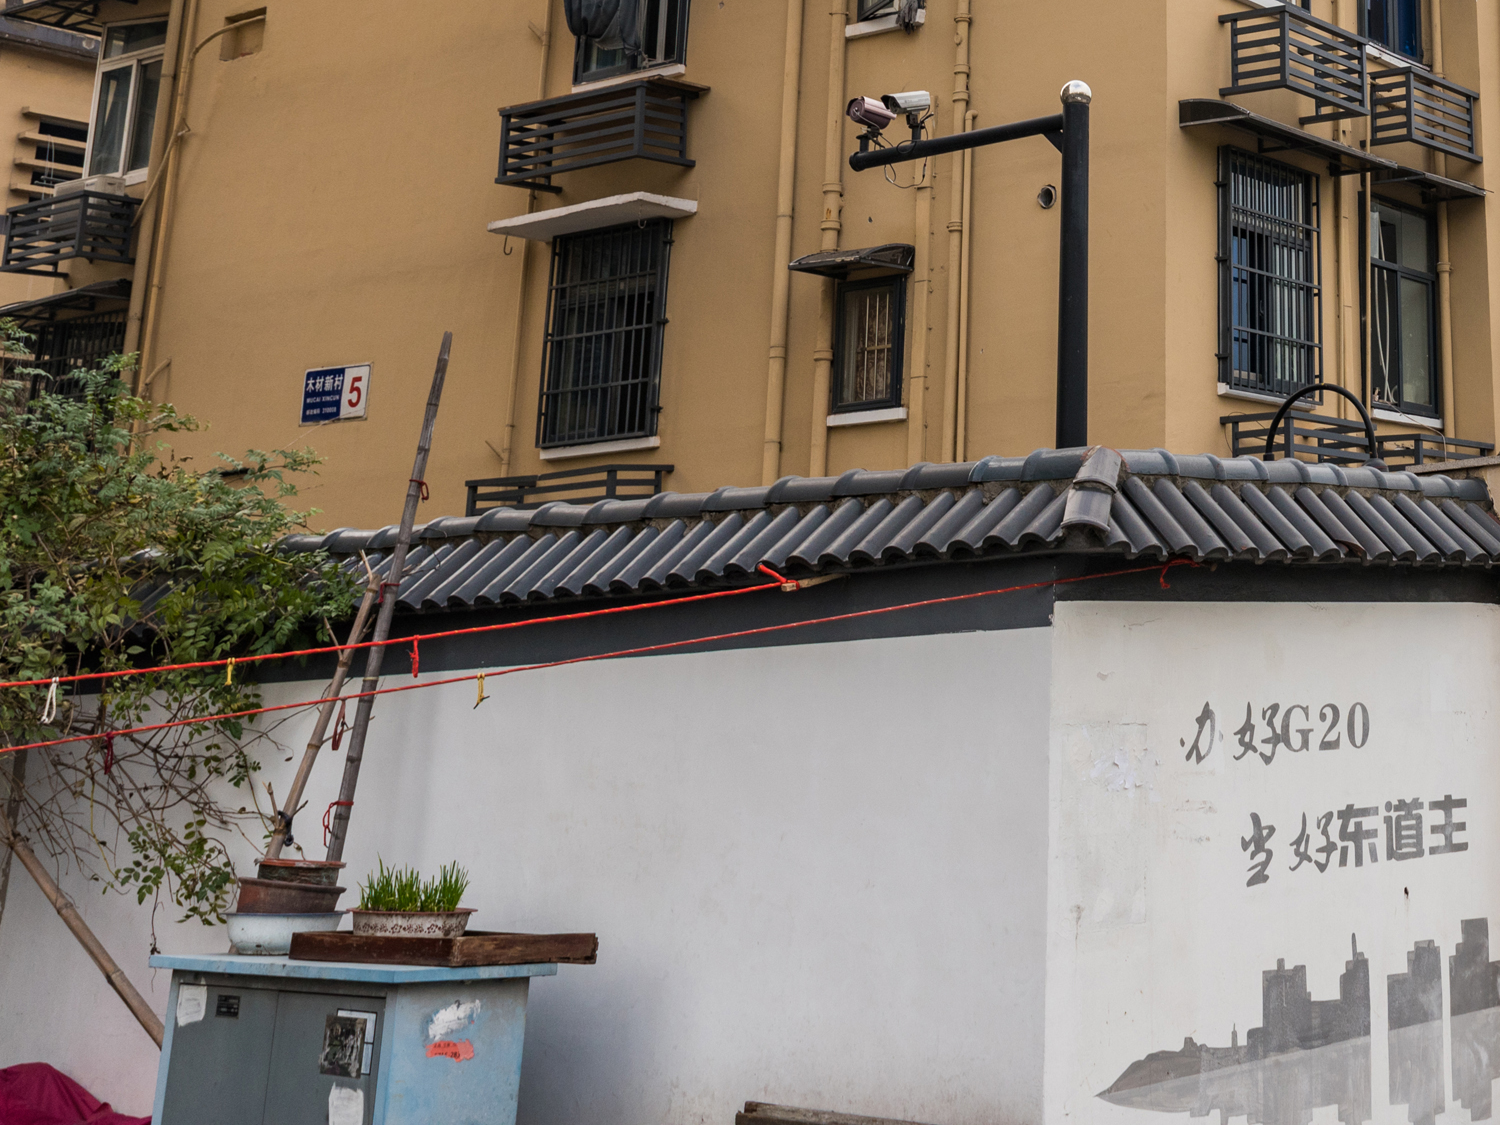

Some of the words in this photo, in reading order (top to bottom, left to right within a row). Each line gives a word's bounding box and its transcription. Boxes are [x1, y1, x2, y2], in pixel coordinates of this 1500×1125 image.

[306, 374, 343, 393] 木材新村
[348, 376, 362, 408] 5
[306, 396, 321, 404] MUCAI
